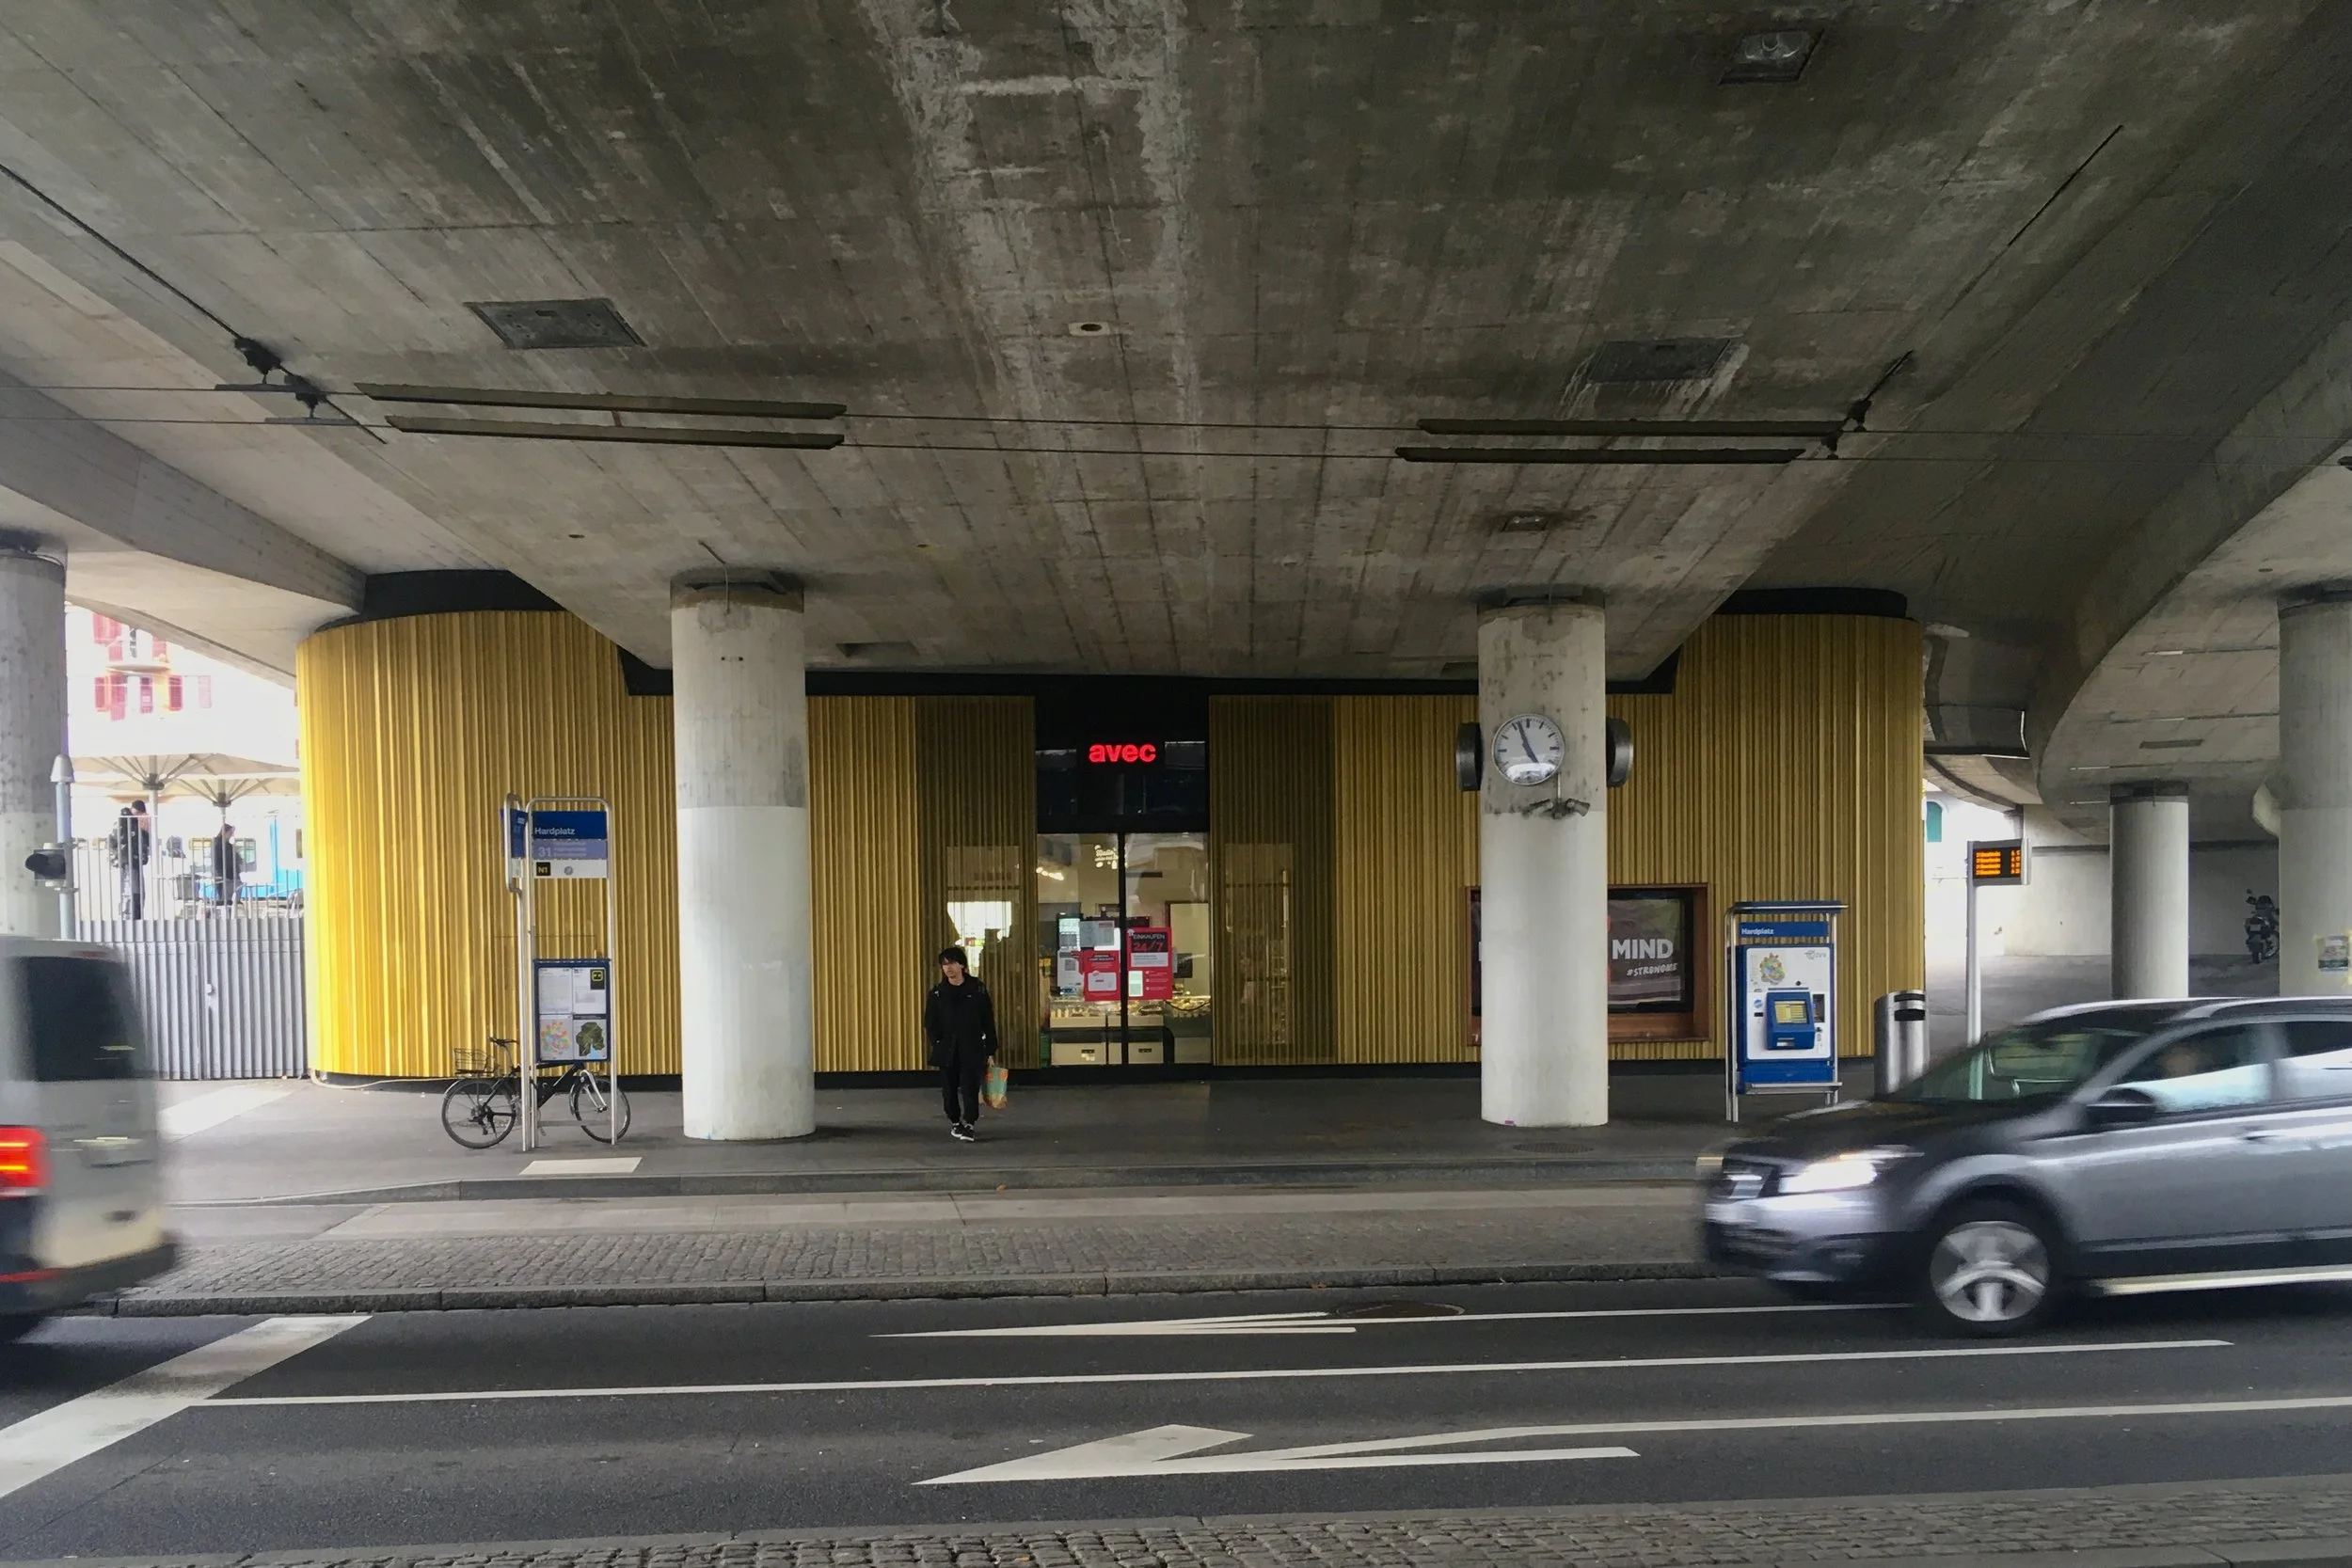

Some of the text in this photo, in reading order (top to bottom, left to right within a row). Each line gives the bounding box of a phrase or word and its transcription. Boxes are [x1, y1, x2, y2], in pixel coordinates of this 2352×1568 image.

[1089, 744, 1157, 763] avec
[534, 827, 576, 836] Hardplatz
[537, 846, 551, 858] 31
[1741, 927, 1774, 936] Hardplatz
[1133, 942, 1164, 952] 24/7
[1612, 939, 1674, 959] MIND
